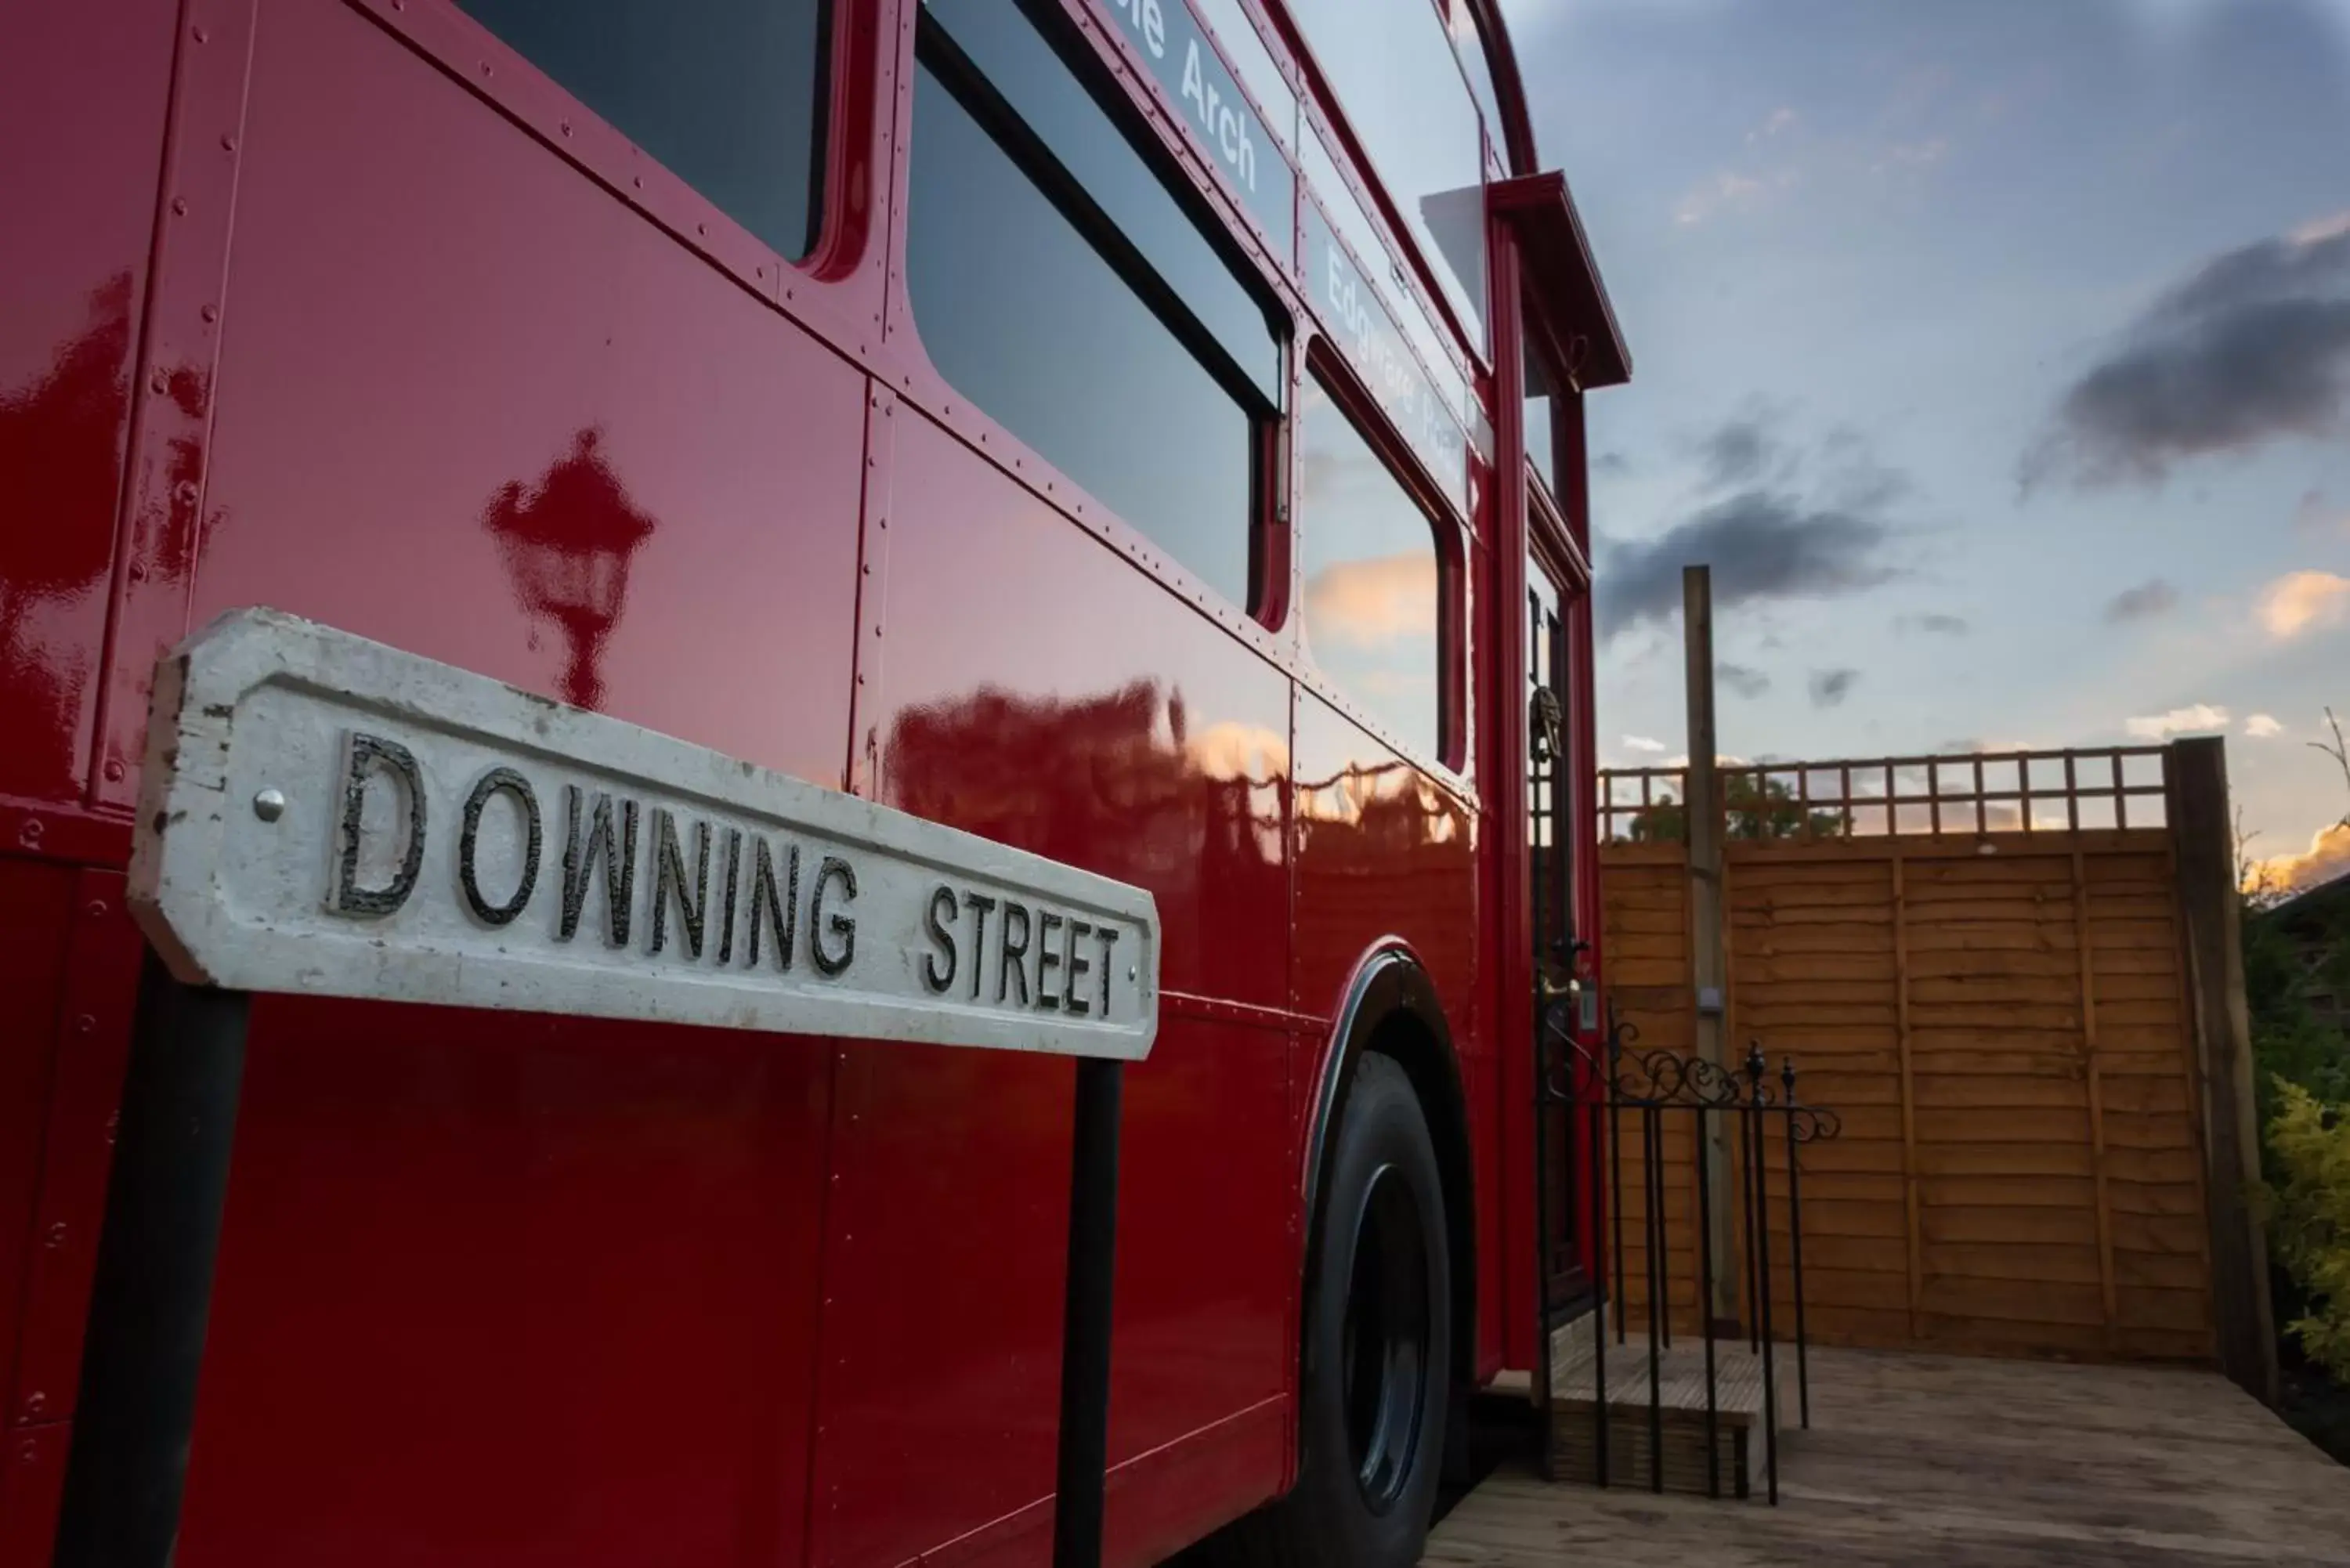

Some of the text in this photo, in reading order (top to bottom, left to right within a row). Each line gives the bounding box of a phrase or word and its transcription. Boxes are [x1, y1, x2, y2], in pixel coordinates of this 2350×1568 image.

[1181, 37, 1256, 193] Arch
[335, 730, 1119, 1017] DOWNING STREET
